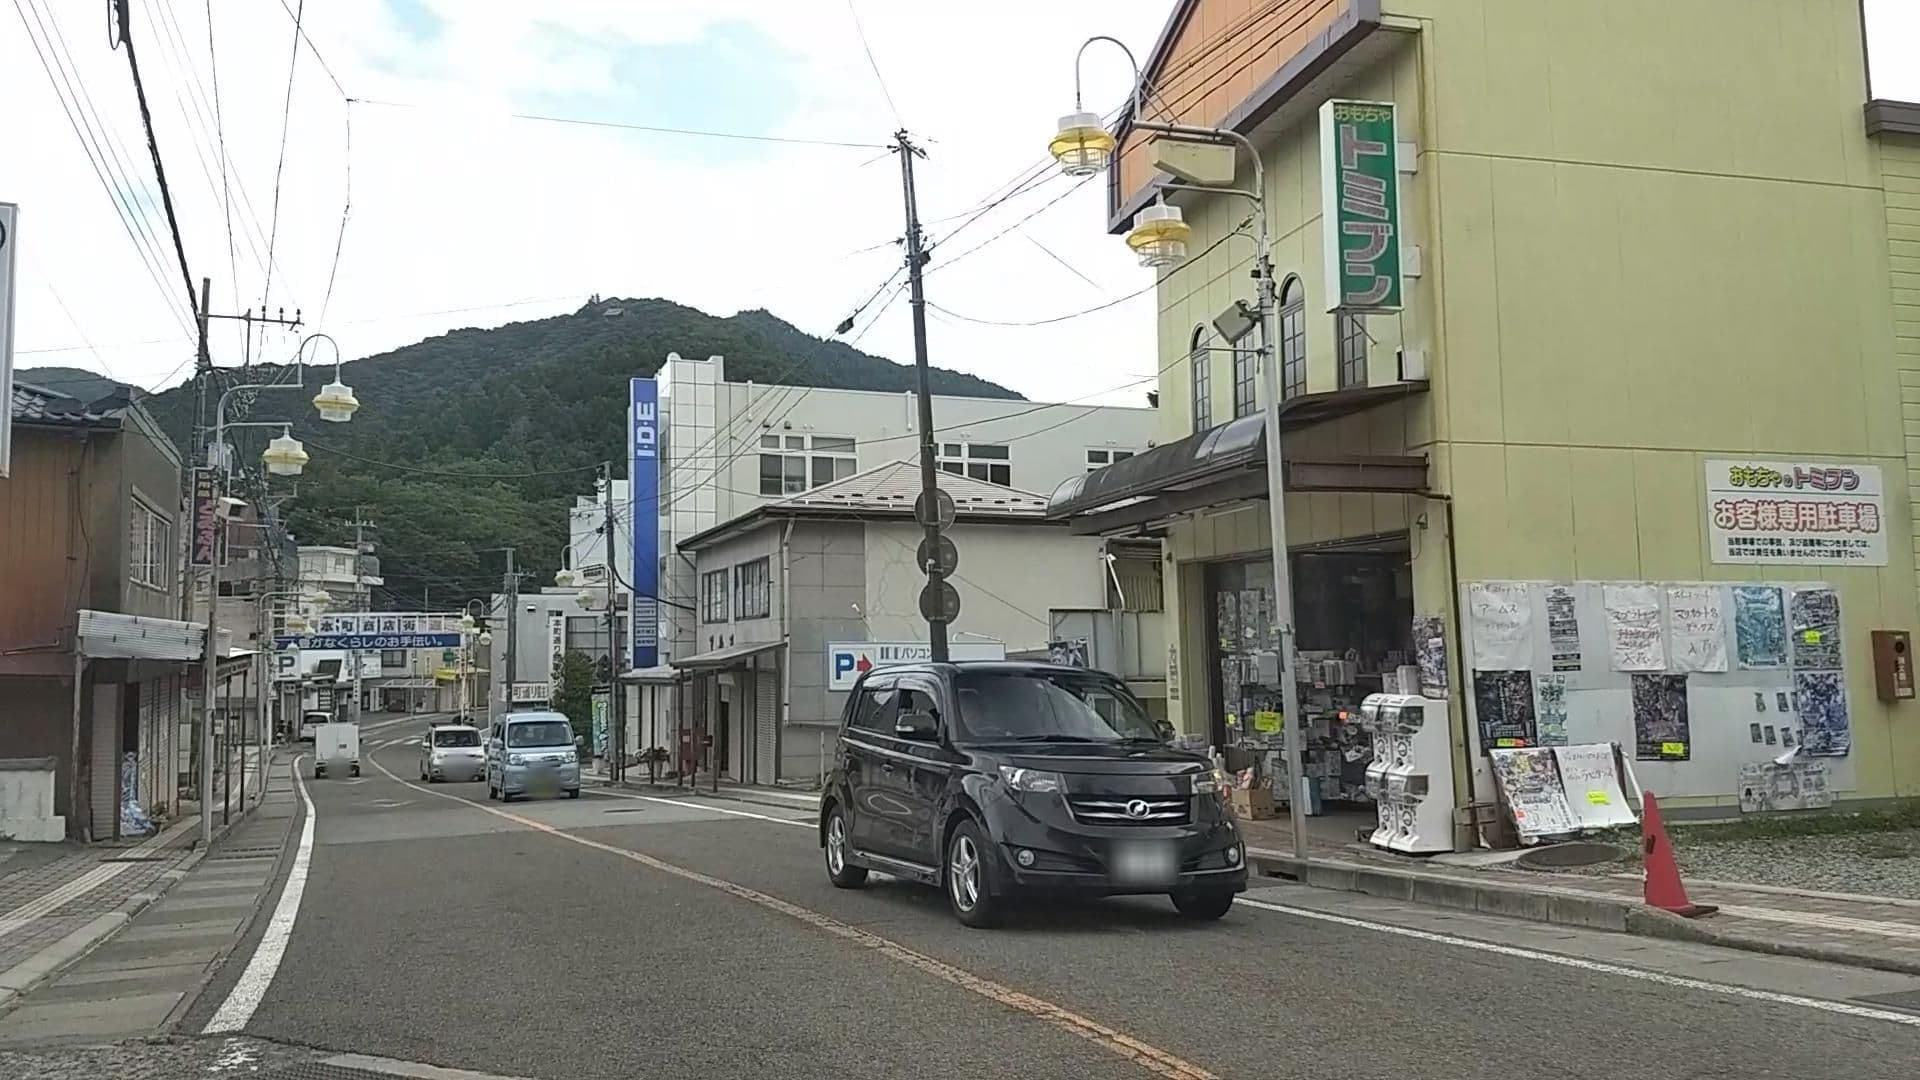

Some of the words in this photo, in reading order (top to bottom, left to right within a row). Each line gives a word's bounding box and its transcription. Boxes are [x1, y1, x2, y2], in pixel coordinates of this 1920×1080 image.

[1335, 105, 1392, 122] おもちゃ
[1714, 499, 1880, 532] お客様専用駐車場
[279, 656, 296, 673] P
[836, 653, 854, 681] P
